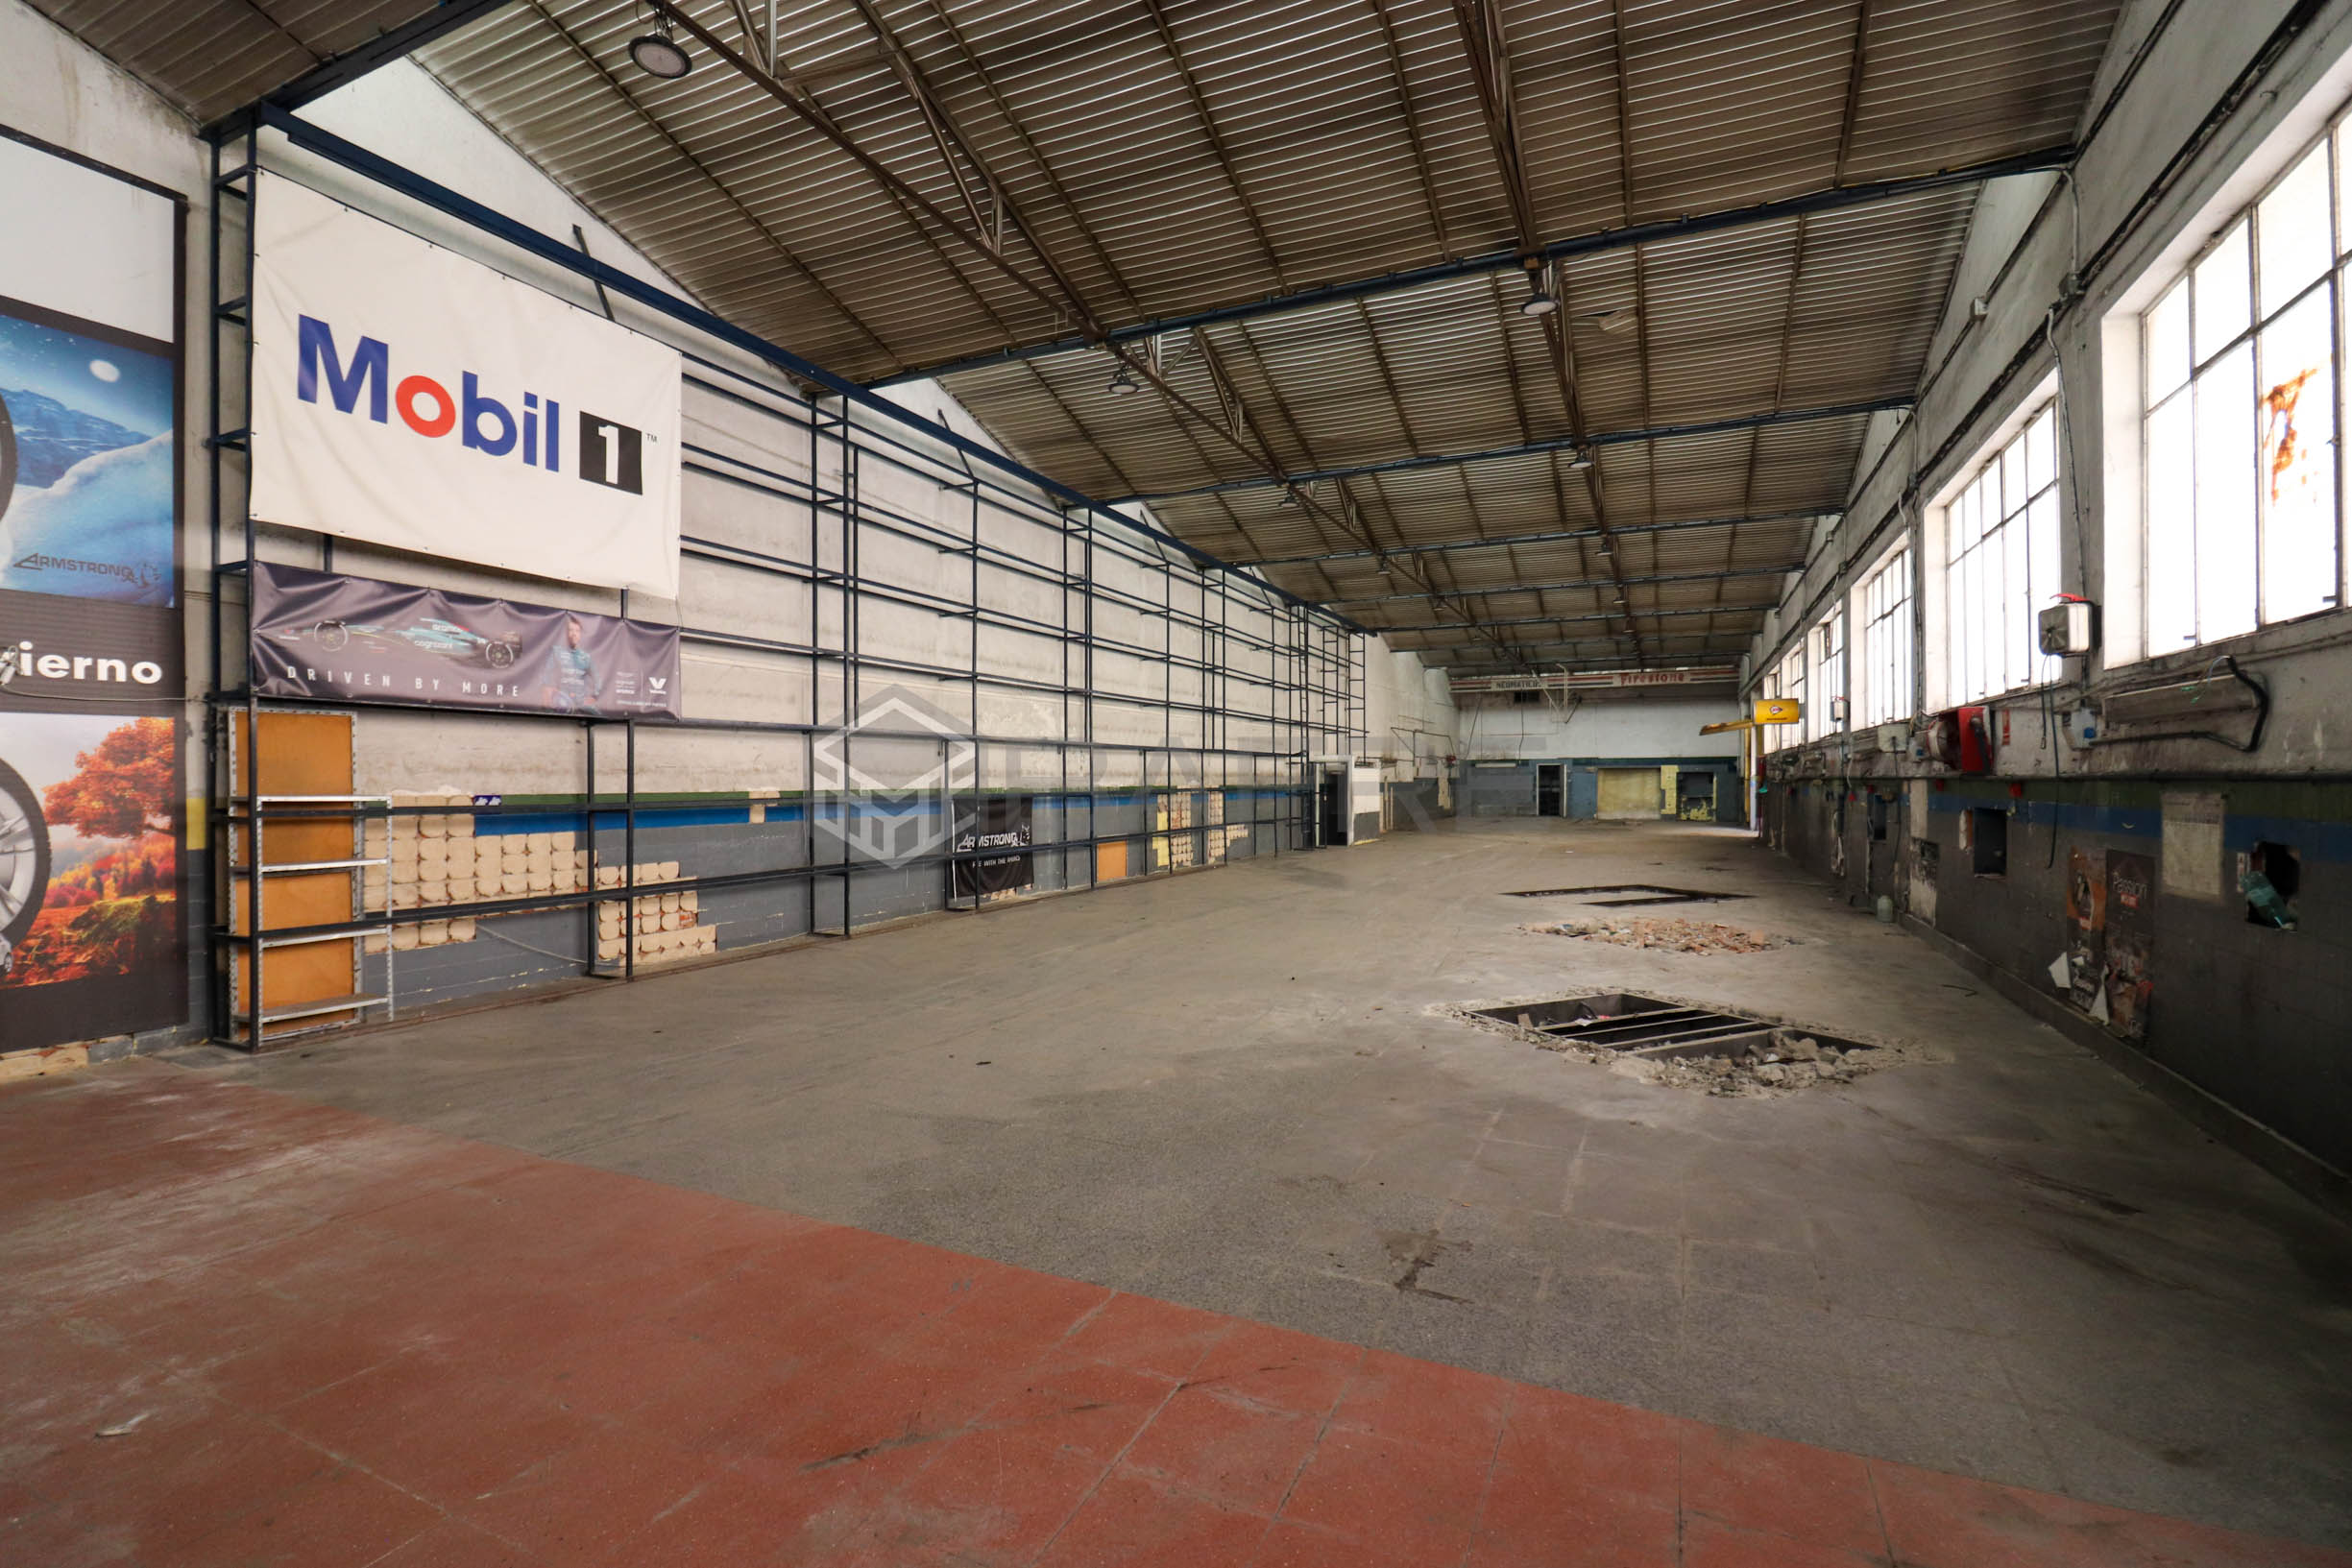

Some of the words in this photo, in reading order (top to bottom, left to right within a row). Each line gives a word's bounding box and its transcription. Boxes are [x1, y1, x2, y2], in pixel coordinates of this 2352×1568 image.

[298, 314, 559, 472] Mobil
[13, 552, 135, 582] ARMSTRONG
[288, 666, 391, 688] DRIVEN
[415, 678, 439, 690] BY
[462, 682, 520, 697] MORE
[1620, 672, 1685, 686] Firestone
